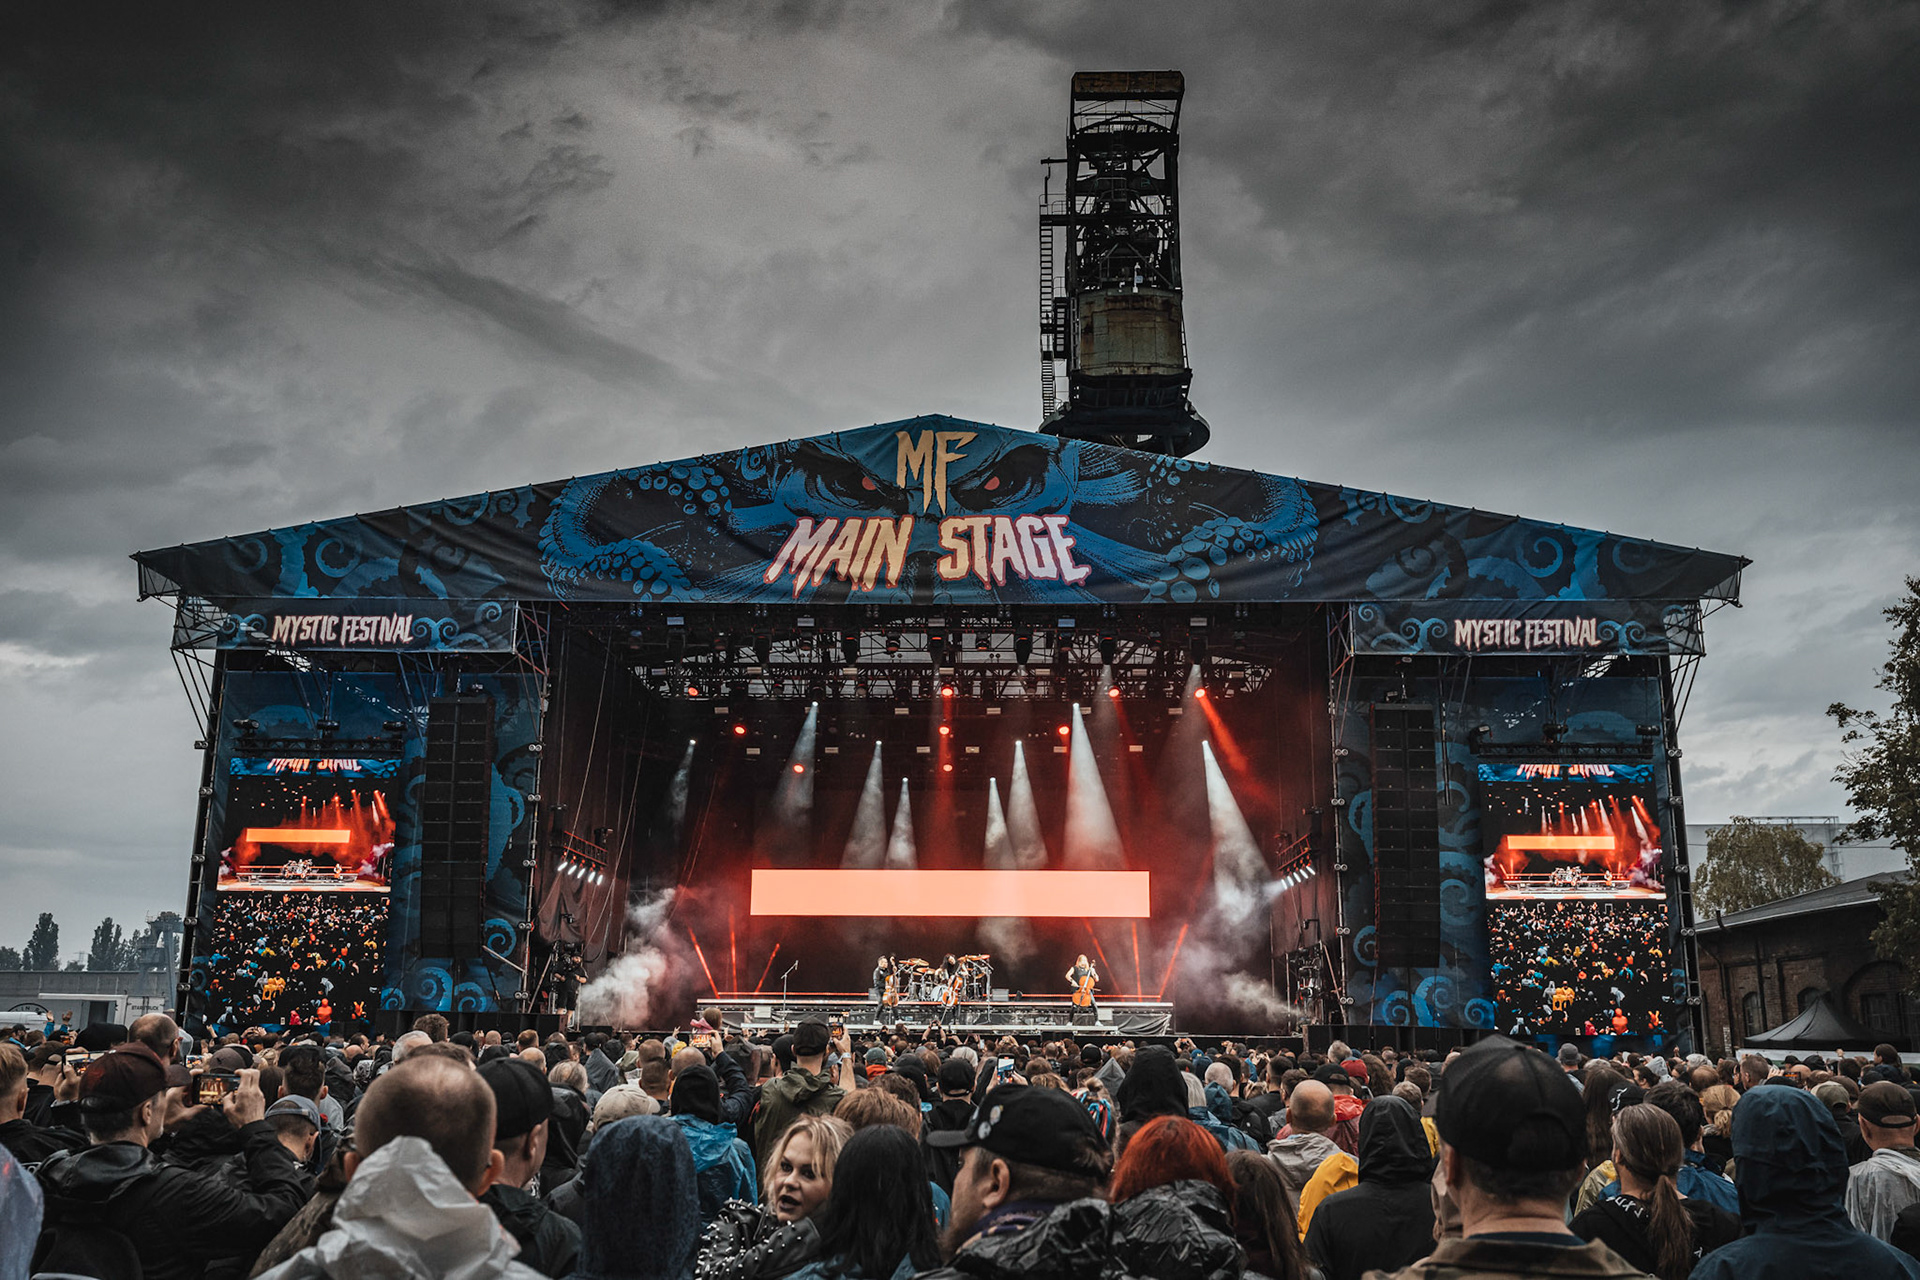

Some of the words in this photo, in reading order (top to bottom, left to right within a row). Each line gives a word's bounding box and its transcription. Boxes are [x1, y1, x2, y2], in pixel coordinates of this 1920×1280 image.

[895, 430, 979, 515] MF
[763, 515, 914, 598] MAIN
[937, 514, 1091, 590] STAGE
[272, 615, 340, 646] MYSTIC
[340, 611, 414, 648] FESTIVAL
[1454, 619, 1521, 651] MYSTIC
[1524, 615, 1602, 652] FESTIVAL
